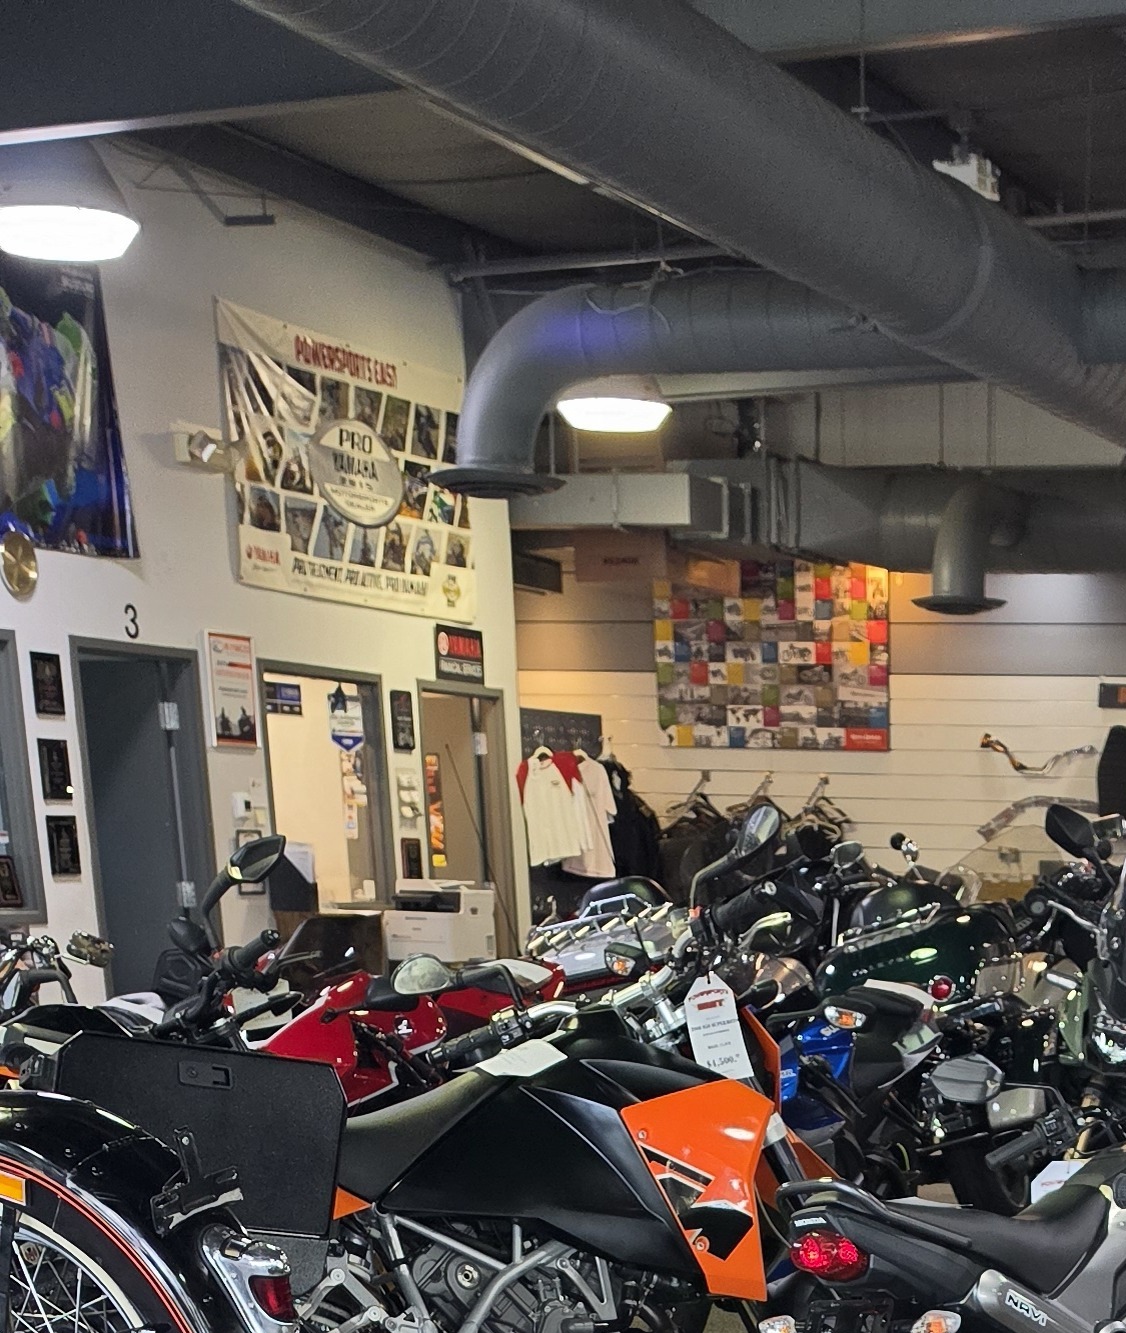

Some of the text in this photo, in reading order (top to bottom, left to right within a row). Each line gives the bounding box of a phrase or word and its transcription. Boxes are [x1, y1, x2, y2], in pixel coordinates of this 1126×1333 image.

[339, 428, 373, 454] PRO
[124, 603, 139, 639] 3
[1005, 1289, 1048, 1327] NAVI
